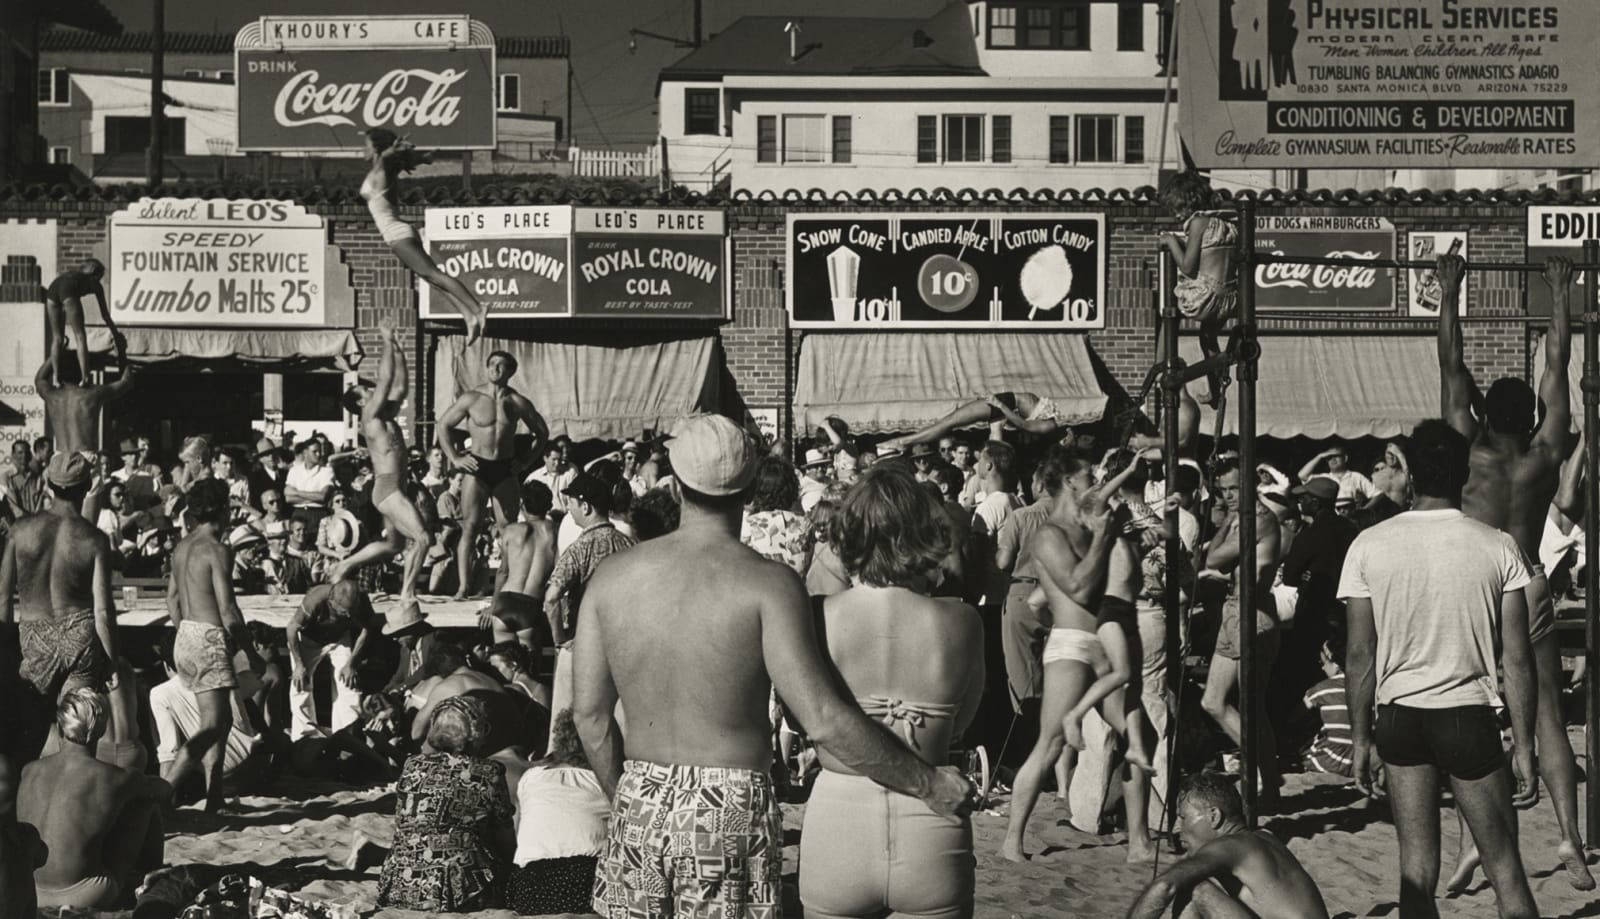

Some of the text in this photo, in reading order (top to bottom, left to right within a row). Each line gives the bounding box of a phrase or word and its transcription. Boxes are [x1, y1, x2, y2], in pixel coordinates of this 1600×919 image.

[1307, 0, 1558, 29] PHYSICAL SERVICES
[274, 22, 459, 39] KHOURY'S CAFE
[1423, 35, 1484, 43] CLEAN
[1320, 43, 1543, 62] Men Women Children All Ages
[248, 61, 297, 73] DRINK
[1307, 65, 1559, 80] TUMBLING BALANCING GYMNASTICS ADAGIO
[274, 68, 469, 127] Coca-Cola
[1297, 84, 1329, 94] 10830
[1336, 84, 1370, 93] SANTA
[1376, 84, 1428, 93] MONICA
[1478, 83, 1527, 93] ARIZONA
[1533, 83, 1568, 93] 75229
[1275, 106, 1568, 129] CONDITIONING & DEVELOPMENT
[1215, 129, 1576, 163] Complete GYMNASIUM FACILITIES Reasonable RATES
[137, 200, 288, 222] Silent LEO'S
[445, 211, 550, 230] LEO'S PLACE
[595, 210, 705, 230] LEO'S PLACE
[1255, 216, 1270, 229] OT
[1275, 216, 1300, 229] DOGS
[1309, 217, 1381, 230] HAMBURGERS
[162, 232, 265, 248] SPEEDY
[440, 243, 468, 251] DRINK
[797, 224, 887, 253] SNOW CONE
[902, 225, 988, 252] CANDIED APPLE
[1004, 224, 1095, 252] COTTON CANDY
[1254, 240, 1276, 248] INK
[121, 252, 310, 273] FOUNTAIN SERVICE
[497, 247, 565, 283] CROWN
[580, 247, 717, 284] ROYAL CROWN
[114, 278, 212, 313] Jumbo
[218, 278, 276, 313] Malts
[475, 278, 520, 296] COLA
[626, 278, 672, 296] COLA
[491, 301, 540, 309] TASTE-TEST
[604, 301, 628, 309] BEST
[629, 301, 641, 309] BY
